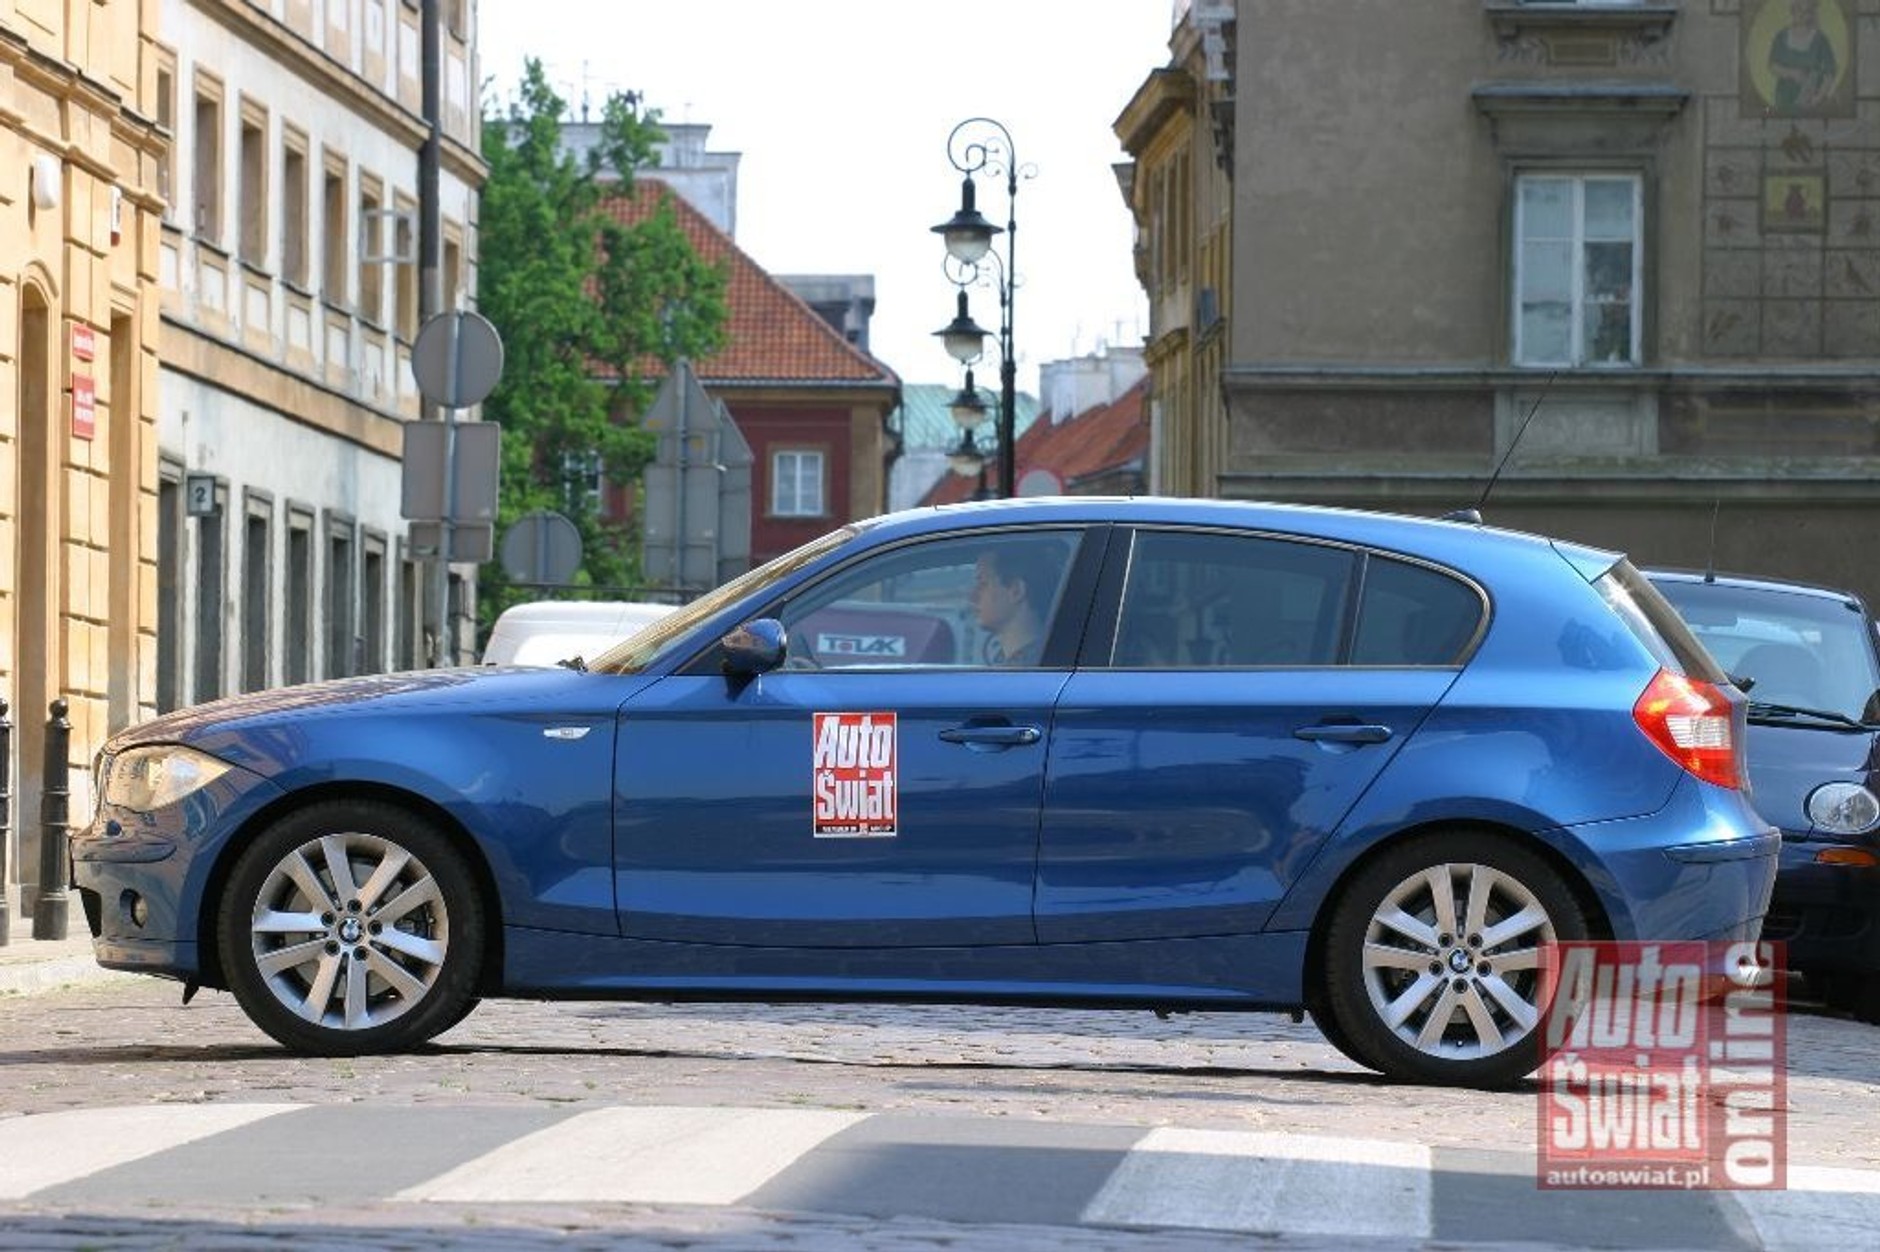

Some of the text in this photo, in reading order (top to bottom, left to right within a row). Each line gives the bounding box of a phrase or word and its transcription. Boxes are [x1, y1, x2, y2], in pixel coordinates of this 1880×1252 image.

[195, 486, 206, 503] 2
[815, 715, 893, 768] Auto
[817, 768, 894, 820] Świat
